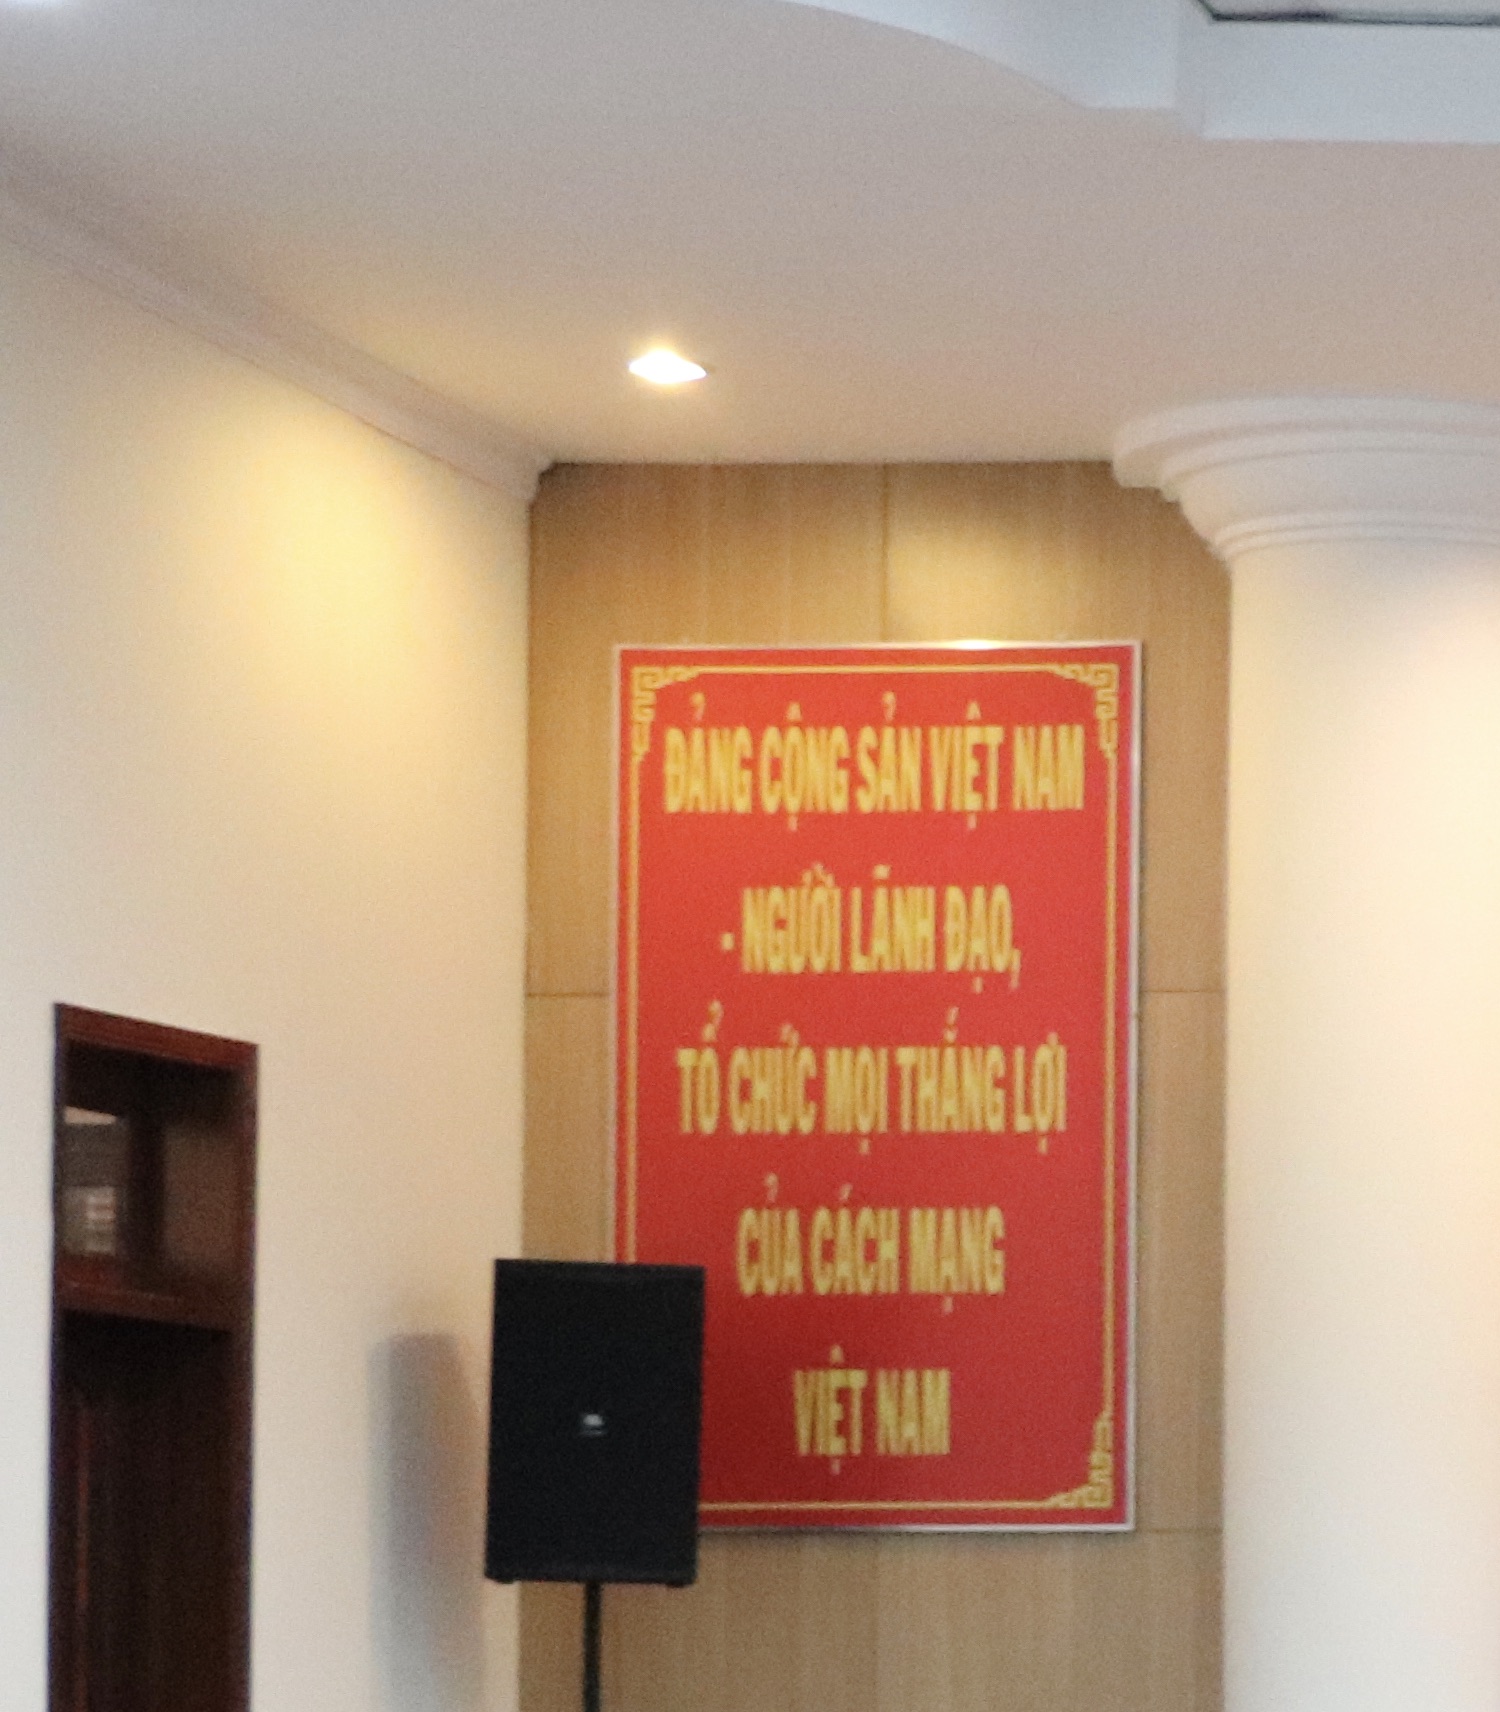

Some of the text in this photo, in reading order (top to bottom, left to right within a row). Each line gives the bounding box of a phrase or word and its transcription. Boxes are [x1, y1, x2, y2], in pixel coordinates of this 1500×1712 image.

[662, 691, 1085, 831] ĐẢNG CỘNG SẢN VIỆT NAM
[741, 862, 843, 974] NGƯỜI
[848, 864, 937, 973] LÃNH
[943, 883, 1021, 993] ĐẠO,
[676, 1000, 1067, 1153] TỔ CHỨC MỌI THẮNG LỢI
[738, 1175, 1005, 1315] CỦA CÁCH MẠNG
[793, 1346, 949, 1475] VIỆT NAM
